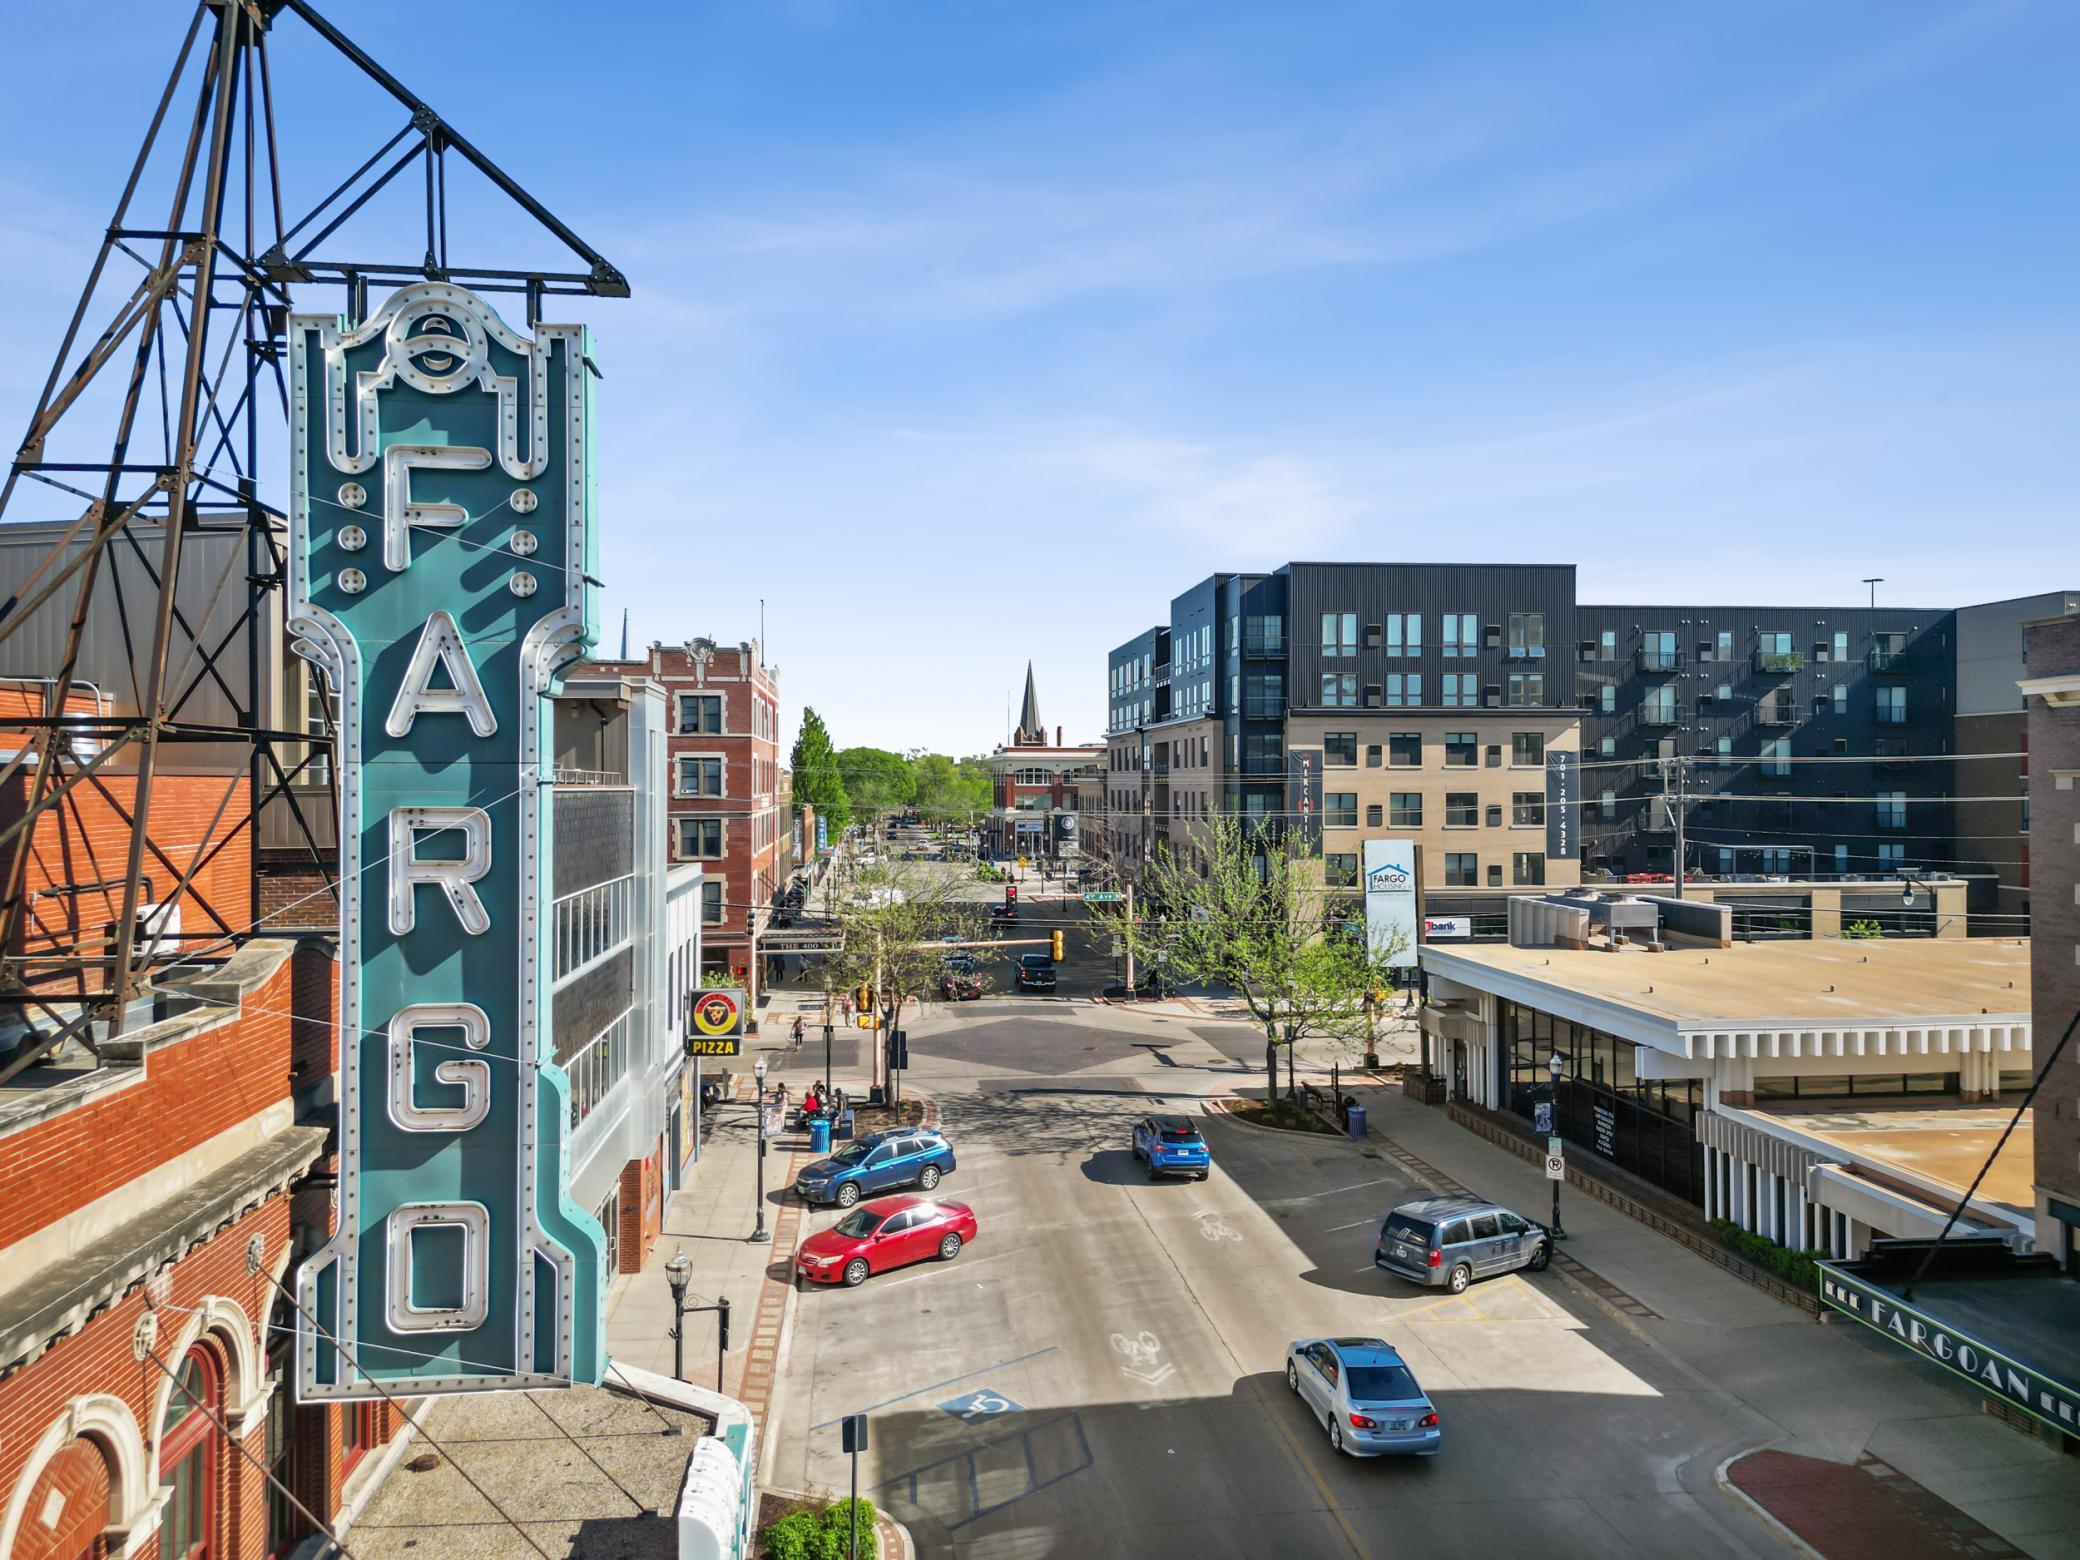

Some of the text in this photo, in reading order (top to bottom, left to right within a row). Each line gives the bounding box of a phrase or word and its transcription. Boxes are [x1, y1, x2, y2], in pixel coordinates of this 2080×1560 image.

[384, 443, 498, 1334] FARGO
[1373, 874, 1406, 883] FARGO
[693, 1041, 734, 1053] PIZZA
[1872, 1299, 2029, 1402] FARGOAN
